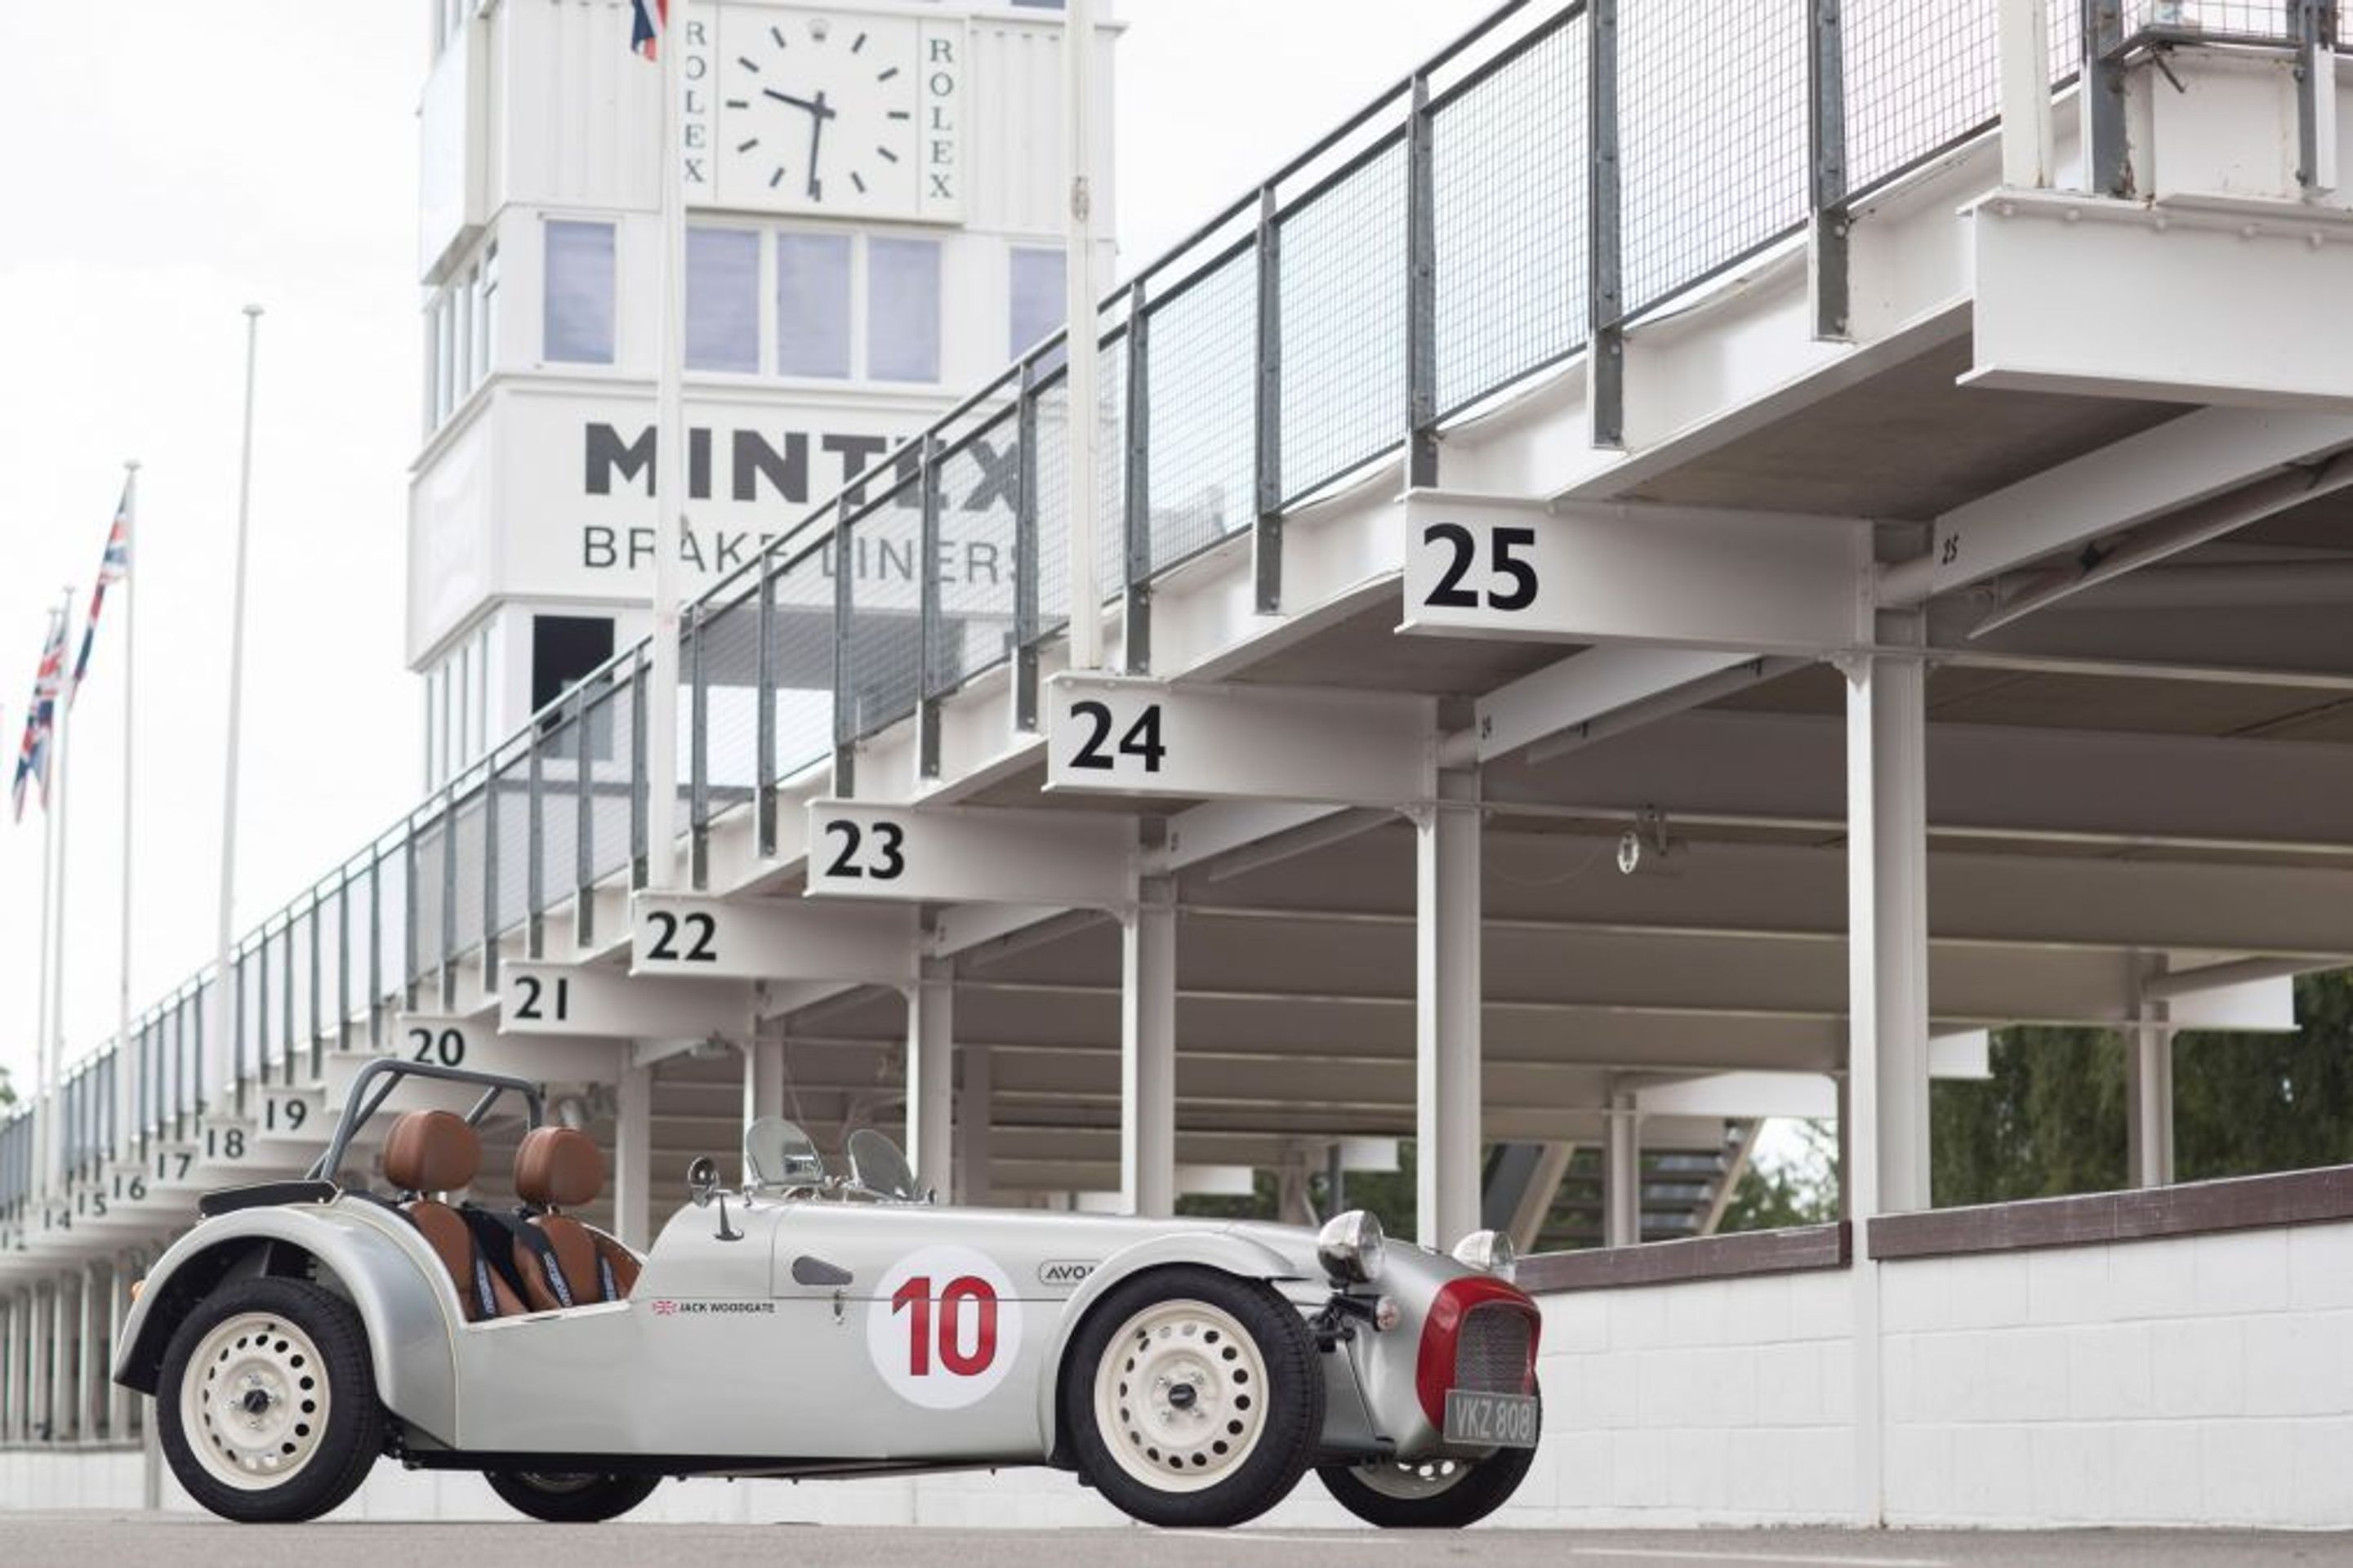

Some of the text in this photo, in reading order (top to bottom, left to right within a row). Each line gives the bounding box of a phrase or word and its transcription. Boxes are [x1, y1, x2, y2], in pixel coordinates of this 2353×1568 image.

[685, 20, 707, 183] ROLEX
[929, 39, 953, 198] ROLEX
[822, 535, 1018, 586] LINER
[1424, 523, 1539, 611] 25
[1068, 701, 1166, 773] 24
[824, 819, 906, 880] 23
[646, 911, 717, 962] 22
[514, 976, 567, 1021] 21
[408, 1027, 464, 1067] 20
[266, 1098, 306, 1130] 19
[158, 1152, 191, 1180] 17
[207, 1128, 243, 1159] 18
[78, 1192, 107, 1217] 15
[114, 1174, 145, 1200] 16
[44, 1208, 71, 1230] 14
[680, 1303, 775, 1313] JACK WOODGATE
[892, 1275, 998, 1376] 10
[1456, 1396, 1531, 1441] VKZ 808
